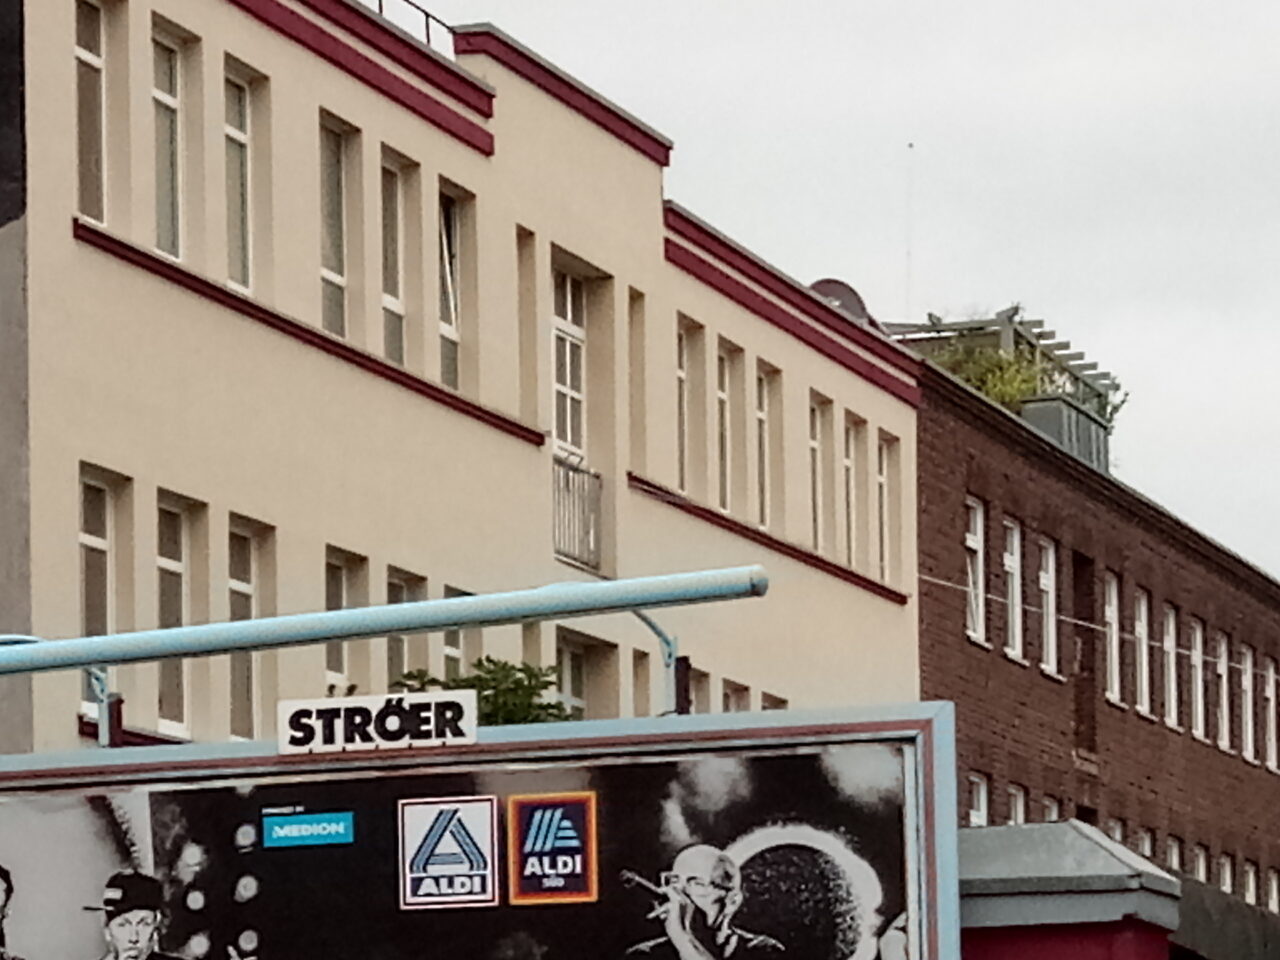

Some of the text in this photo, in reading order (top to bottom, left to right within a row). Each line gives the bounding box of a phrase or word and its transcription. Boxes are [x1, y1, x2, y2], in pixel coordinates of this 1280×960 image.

[288, 697, 466, 746] STRÖER
[272, 821, 344, 838] MEDION
[524, 854, 582, 876] ALDI
[417, 876, 481, 895] ALDI
